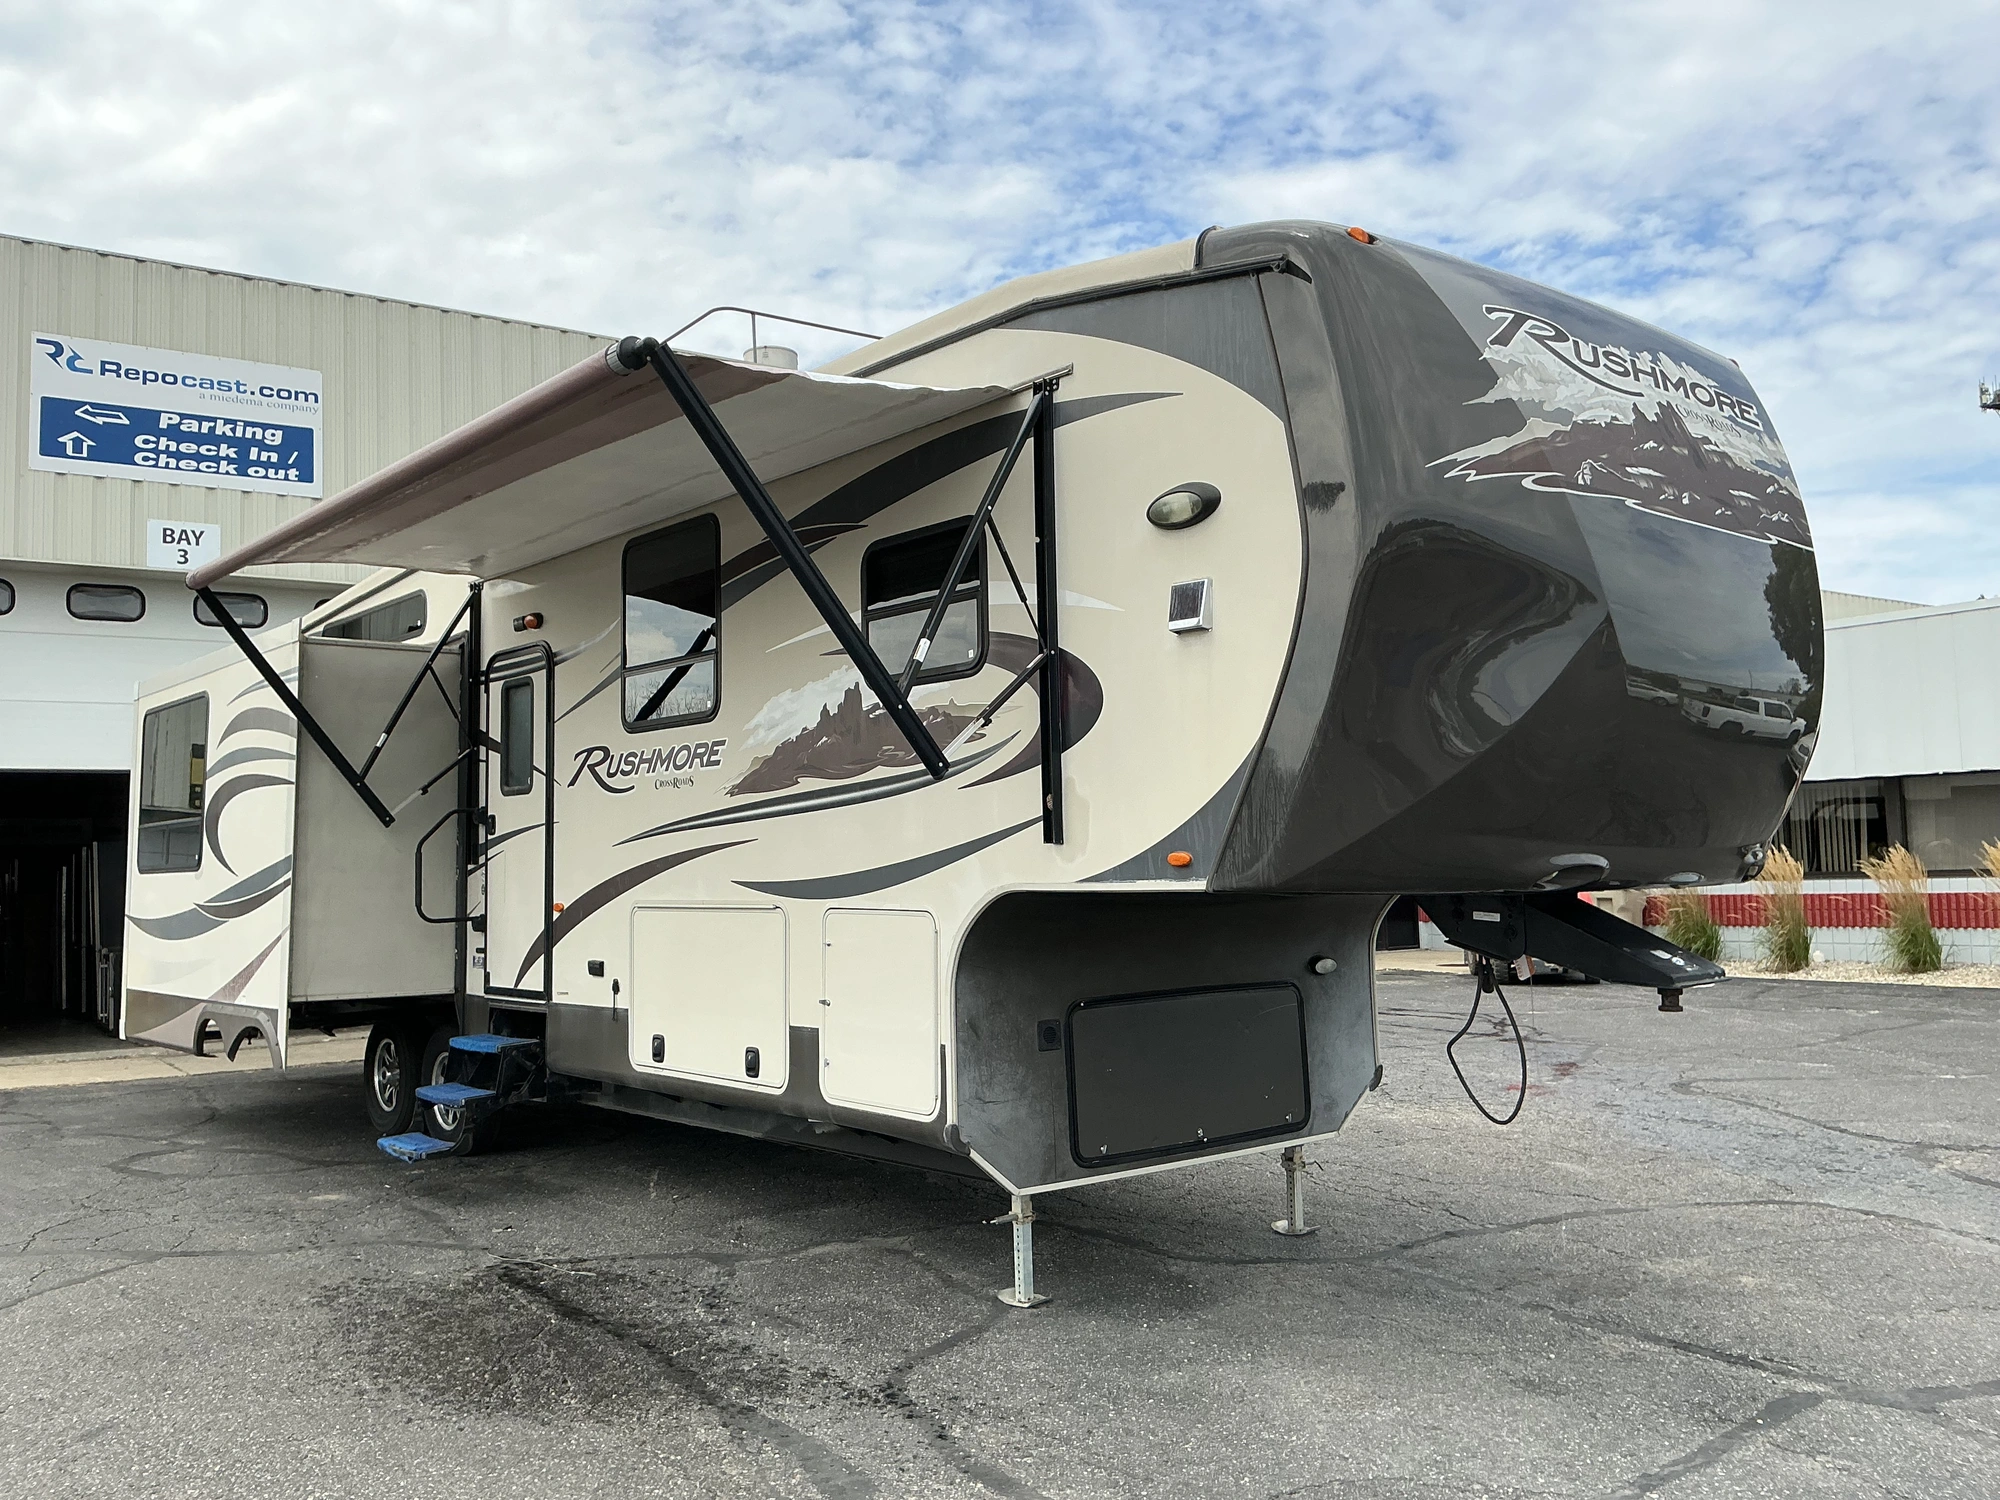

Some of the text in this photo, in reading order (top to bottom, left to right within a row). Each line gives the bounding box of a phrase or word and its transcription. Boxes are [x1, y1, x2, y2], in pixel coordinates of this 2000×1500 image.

[99, 359, 319, 405] Repocast.com
[1483, 305, 1762, 430] RUSHMORE
[199, 392, 319, 416] a miedema company
[158, 412, 283, 445] Parking
[133, 434, 299, 464] Check In /
[133, 451, 299, 481] Check out
[162, 527, 205, 547] BAY
[176, 549, 189, 565] 3
[567, 739, 727, 793] RUSHMORE
